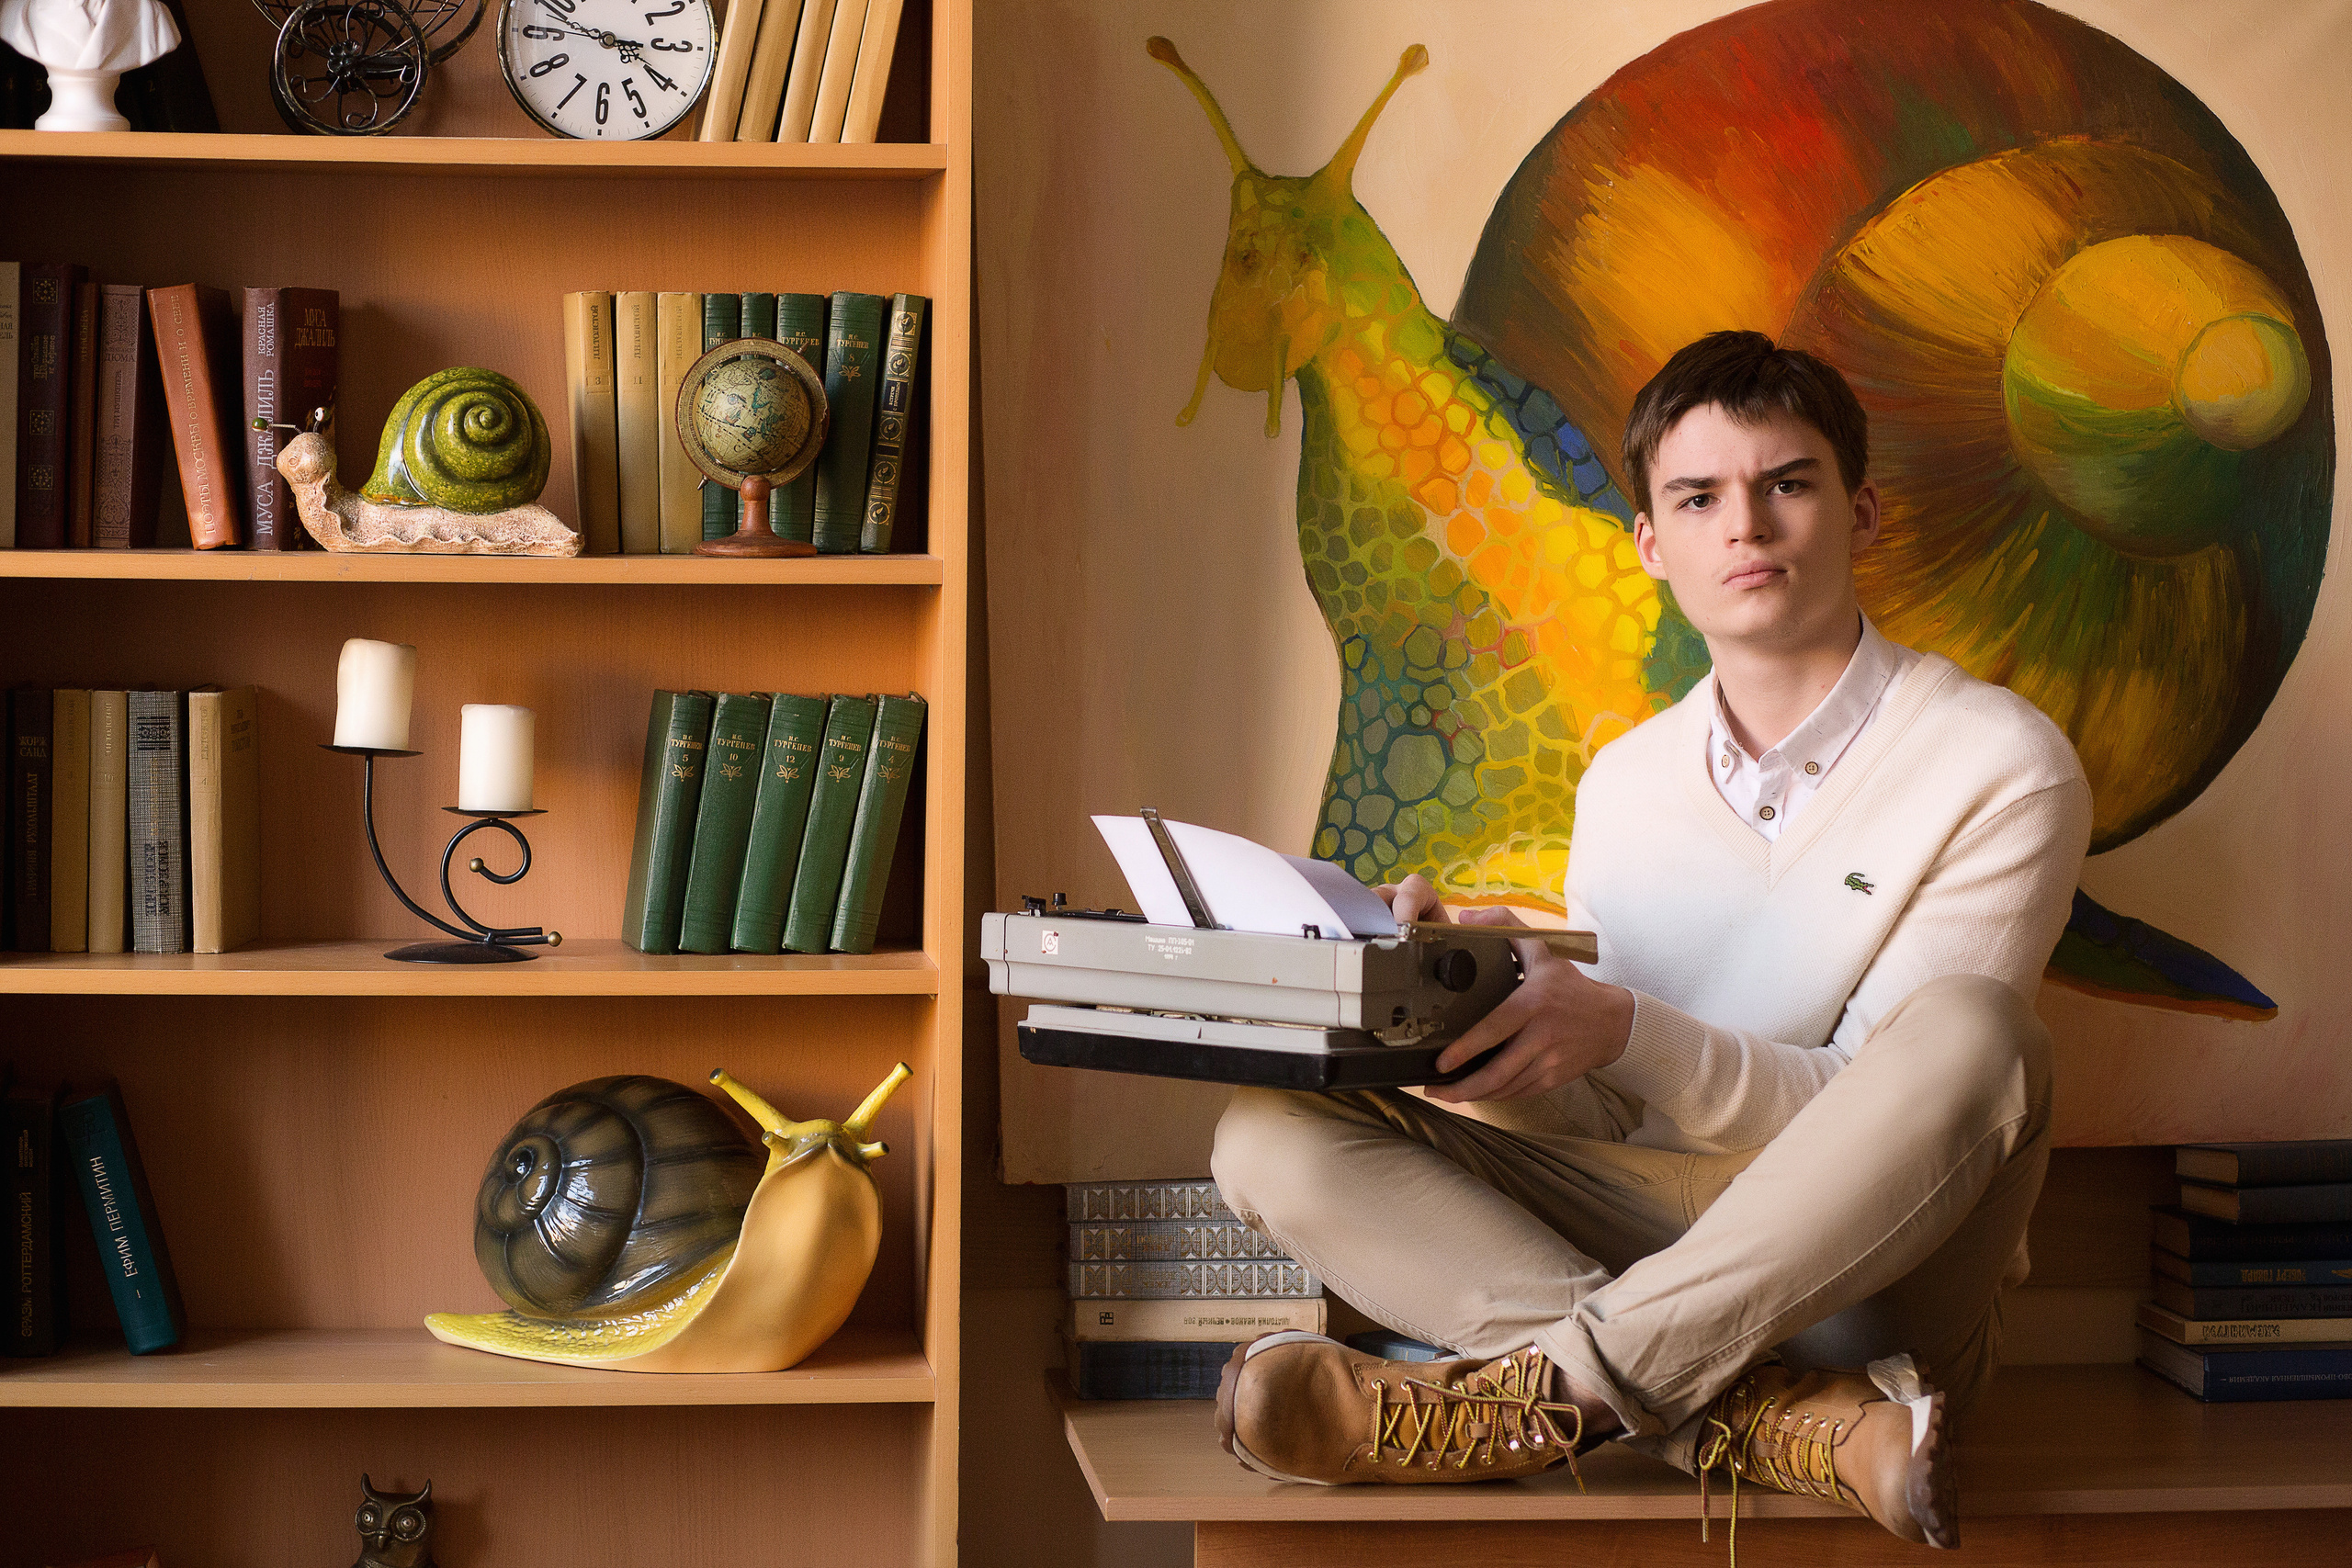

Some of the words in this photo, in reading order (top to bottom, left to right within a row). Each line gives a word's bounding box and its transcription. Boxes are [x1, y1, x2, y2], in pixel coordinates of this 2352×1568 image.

[644, 0, 685, 26] 2
[522, 24, 566, 41] 9
[650, 38, 693, 53] 3
[529, 52, 570, 78] 8
[643, 63, 679, 92] 4
[556, 73, 588, 110] 7
[621, 77, 647, 118] 5
[595, 82, 610, 125] 6
[170, 295, 184, 325] СЕБЕ
[304, 308, 328, 327] МУСА
[176, 328, 184, 336] О
[257, 306, 266, 355] КРАСНАЯ
[266, 301, 275, 357] РОМАШКА
[294, 327, 336, 349] ДЖАЛИЛЬ
[836, 338, 869, 349] ТУРГЕНЕВ
[103, 353, 136, 363] ДЮМА
[848, 354, 854, 362] 8
[181, 354, 197, 410] ВРЕМЕНИ
[594, 377, 601, 385] 3
[113, 369, 122, 413] МУШКЕТЕРА
[113, 414, 121, 429] ТРИ
[189, 423, 210, 483] МОСКВЫ
[198, 483, 217, 535] ПОЭТЫ
[256, 479, 274, 536] МУСА
[18, 736, 47, 746] ЖОРЖ
[671, 738, 703, 750] ТУРГЕНЕВ
[716, 738, 755, 750] ТУРГЕНЕВ
[774, 739, 812, 752] ТУРГЕНЕВ
[828, 739, 862, 752] ТУРГЕНЕВ
[878, 739, 911, 752] ТУРГЕНЕВ
[19, 746, 47, 758] САНД
[729, 753, 739, 761] 10
[786, 755, 796, 763] 12
[887, 755, 895, 763] 4
[144, 843, 156, 917] ПРОСПЕР
[158, 840, 170, 917] МЕРИМЕ
[89, 1156, 124, 1232] ПЕРМИТИН
[20, 1191, 33, 1294] РОТТЕРДАМСКИЙ
[114, 1235, 139, 1278] ЕФИМ
[2241, 1269, 2273, 1282] ГОВАРД
[1198, 1317, 1225, 1326] ВЕЧНЫЙ
[1230, 1317, 1256, 1325] ИВАНОВ
[1258, 1316, 1290, 1326] АНАТОЛИЙ
[2228, 1374, 2270, 1383] АКАДЕМИЯ
[2271, 1373, 2352, 1382] ОВО-ПРОМЫШЛЕННАЯ
